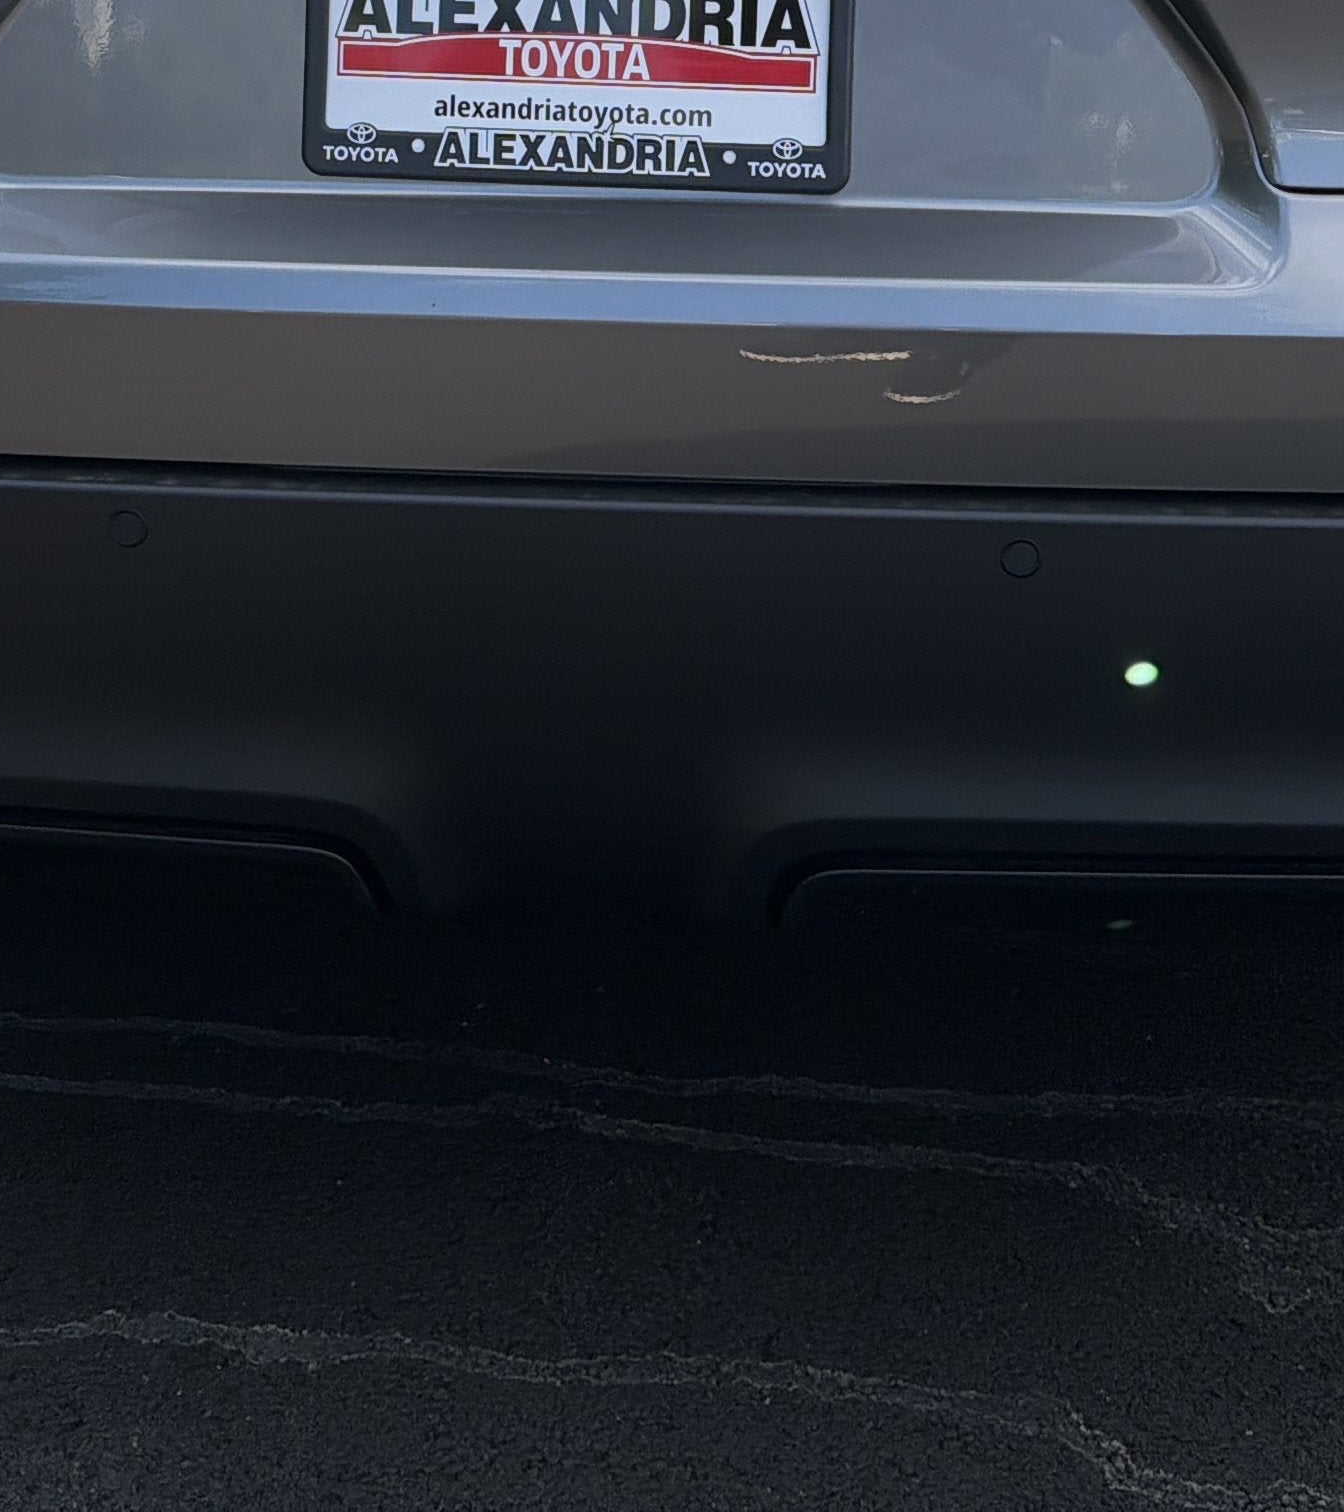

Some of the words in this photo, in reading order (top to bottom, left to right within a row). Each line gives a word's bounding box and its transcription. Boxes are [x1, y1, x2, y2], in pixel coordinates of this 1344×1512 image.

[498, 38, 651, 81] TOYOTA
[433, 95, 713, 128] alexandriatoyota.com
[323, 145, 399, 164] TOYOTA
[434, 127, 710, 177] ALEXANDRIA
[748, 161, 827, 180] TOYOTA
